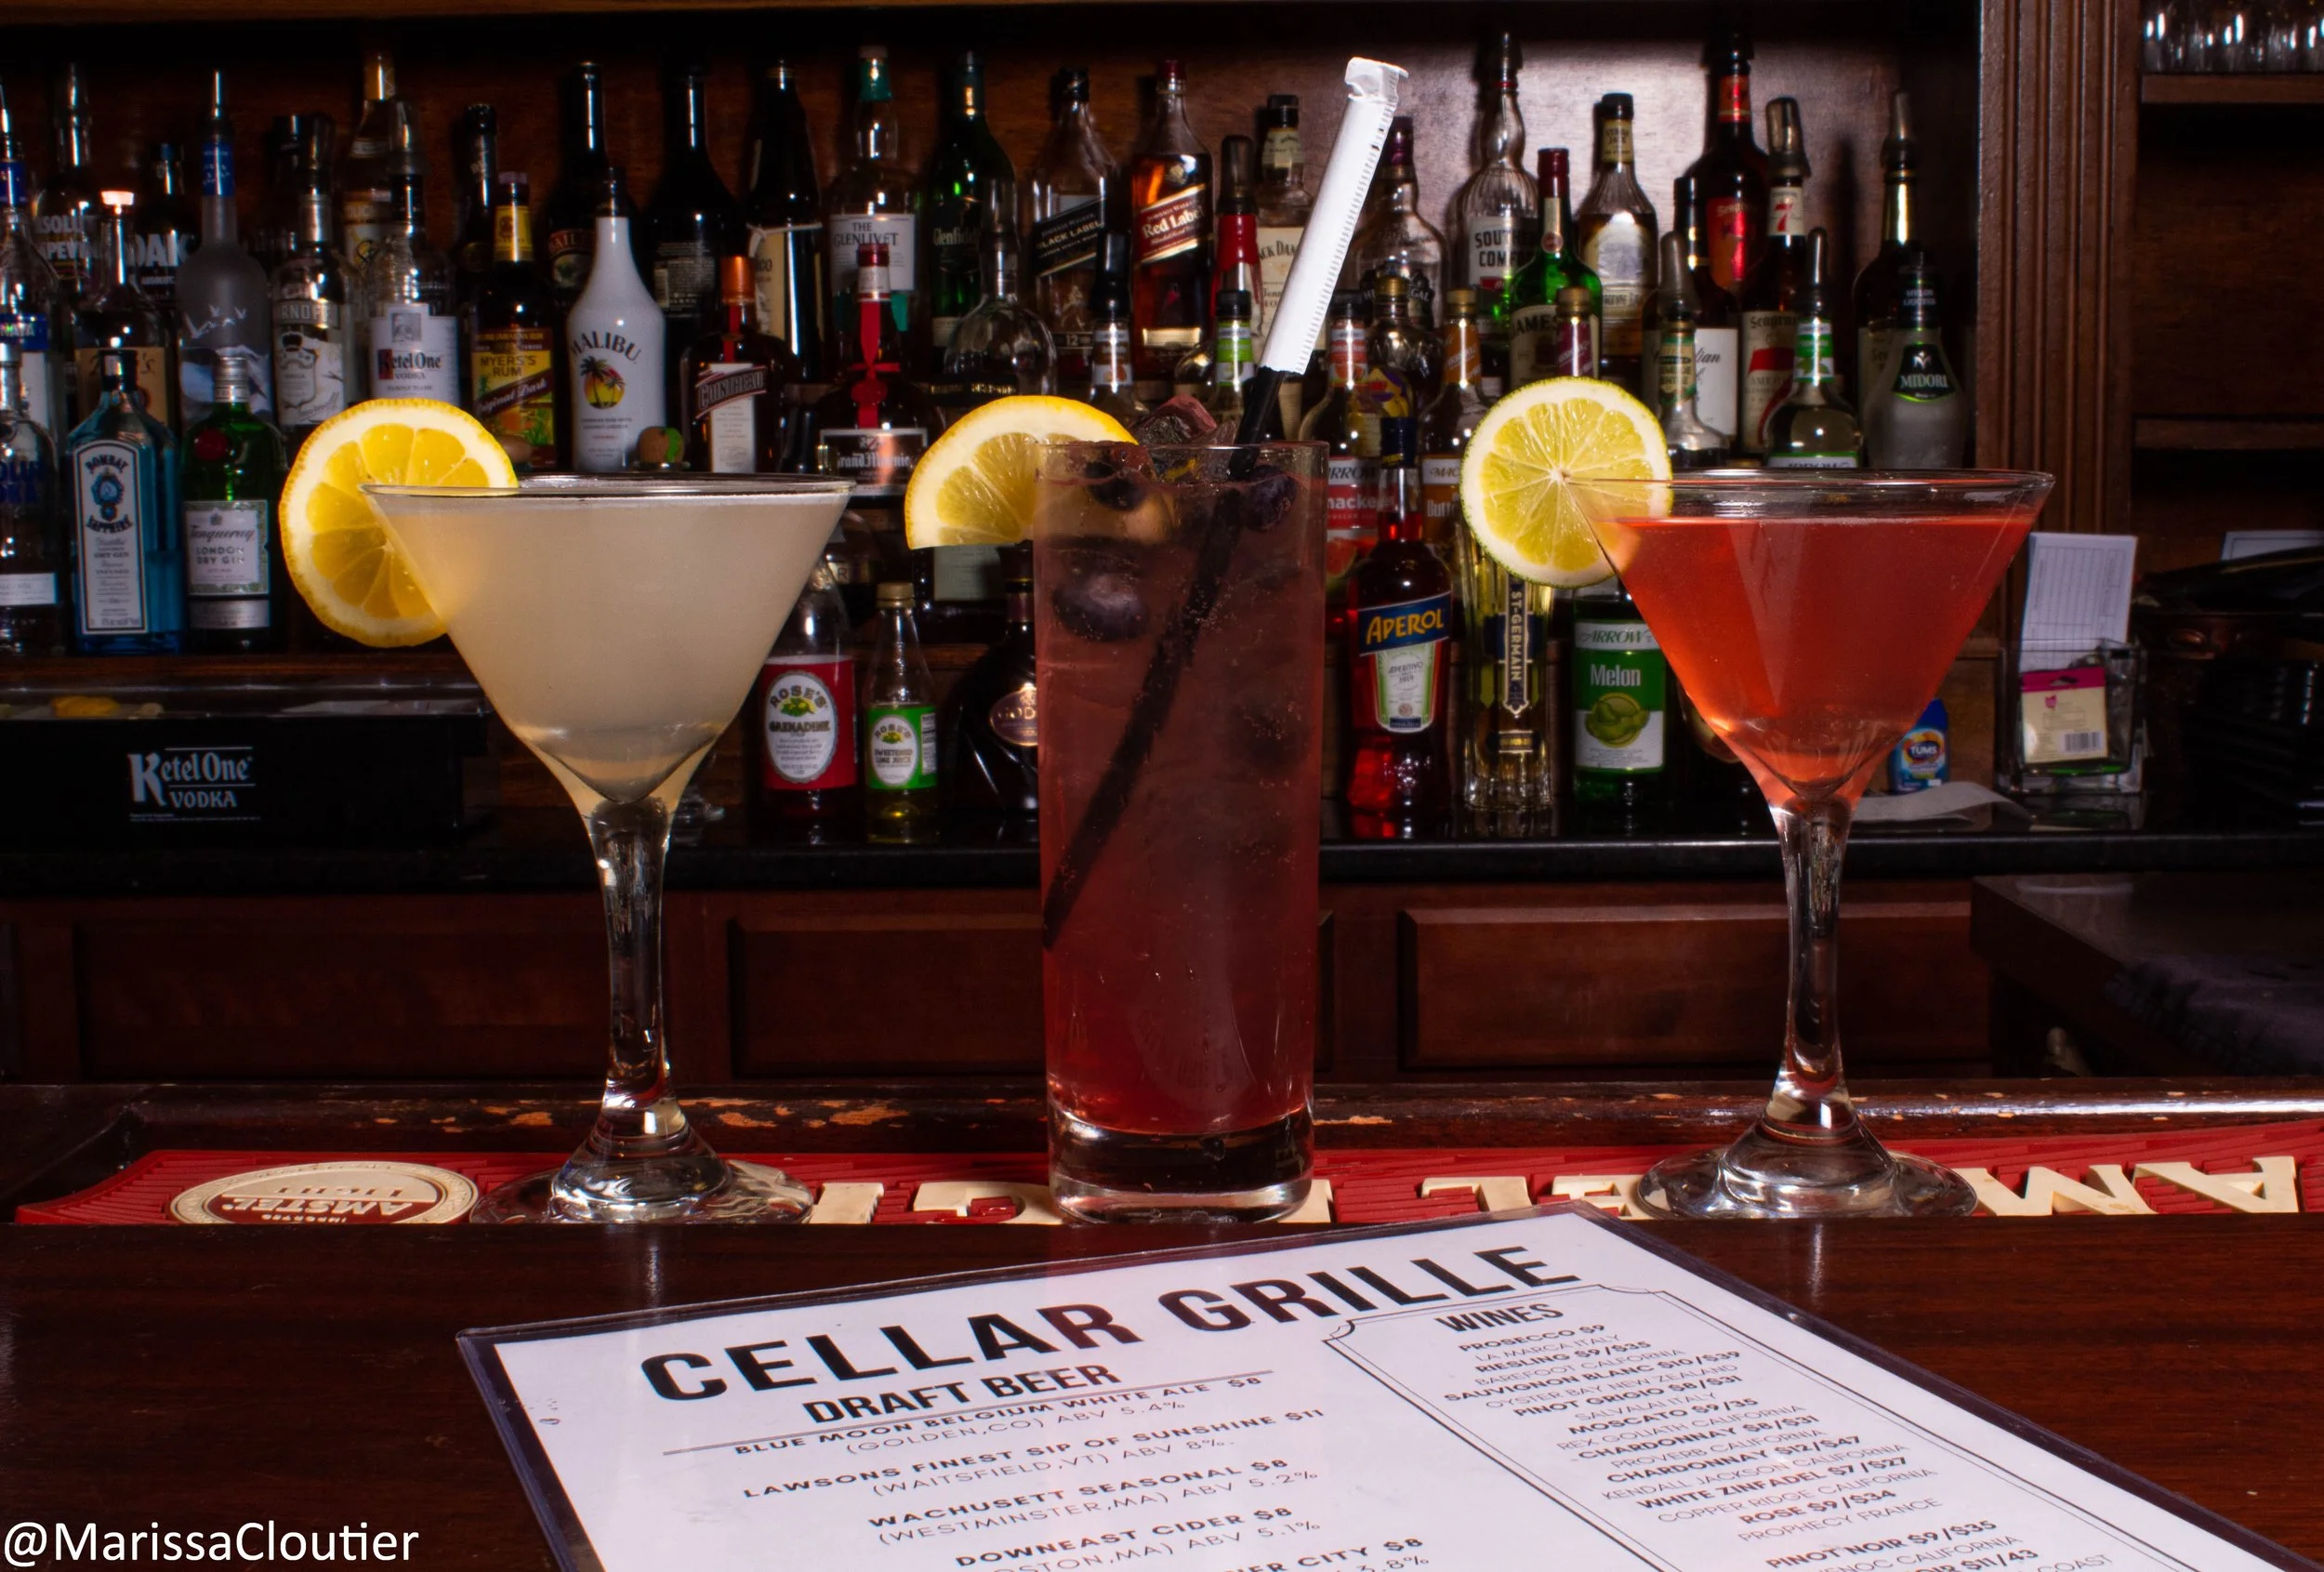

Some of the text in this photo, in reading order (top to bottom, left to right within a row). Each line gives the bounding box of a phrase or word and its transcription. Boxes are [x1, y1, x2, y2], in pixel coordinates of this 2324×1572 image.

[852, 222, 873, 231] THE
[1071, 220, 1103, 237] LABEL
[1142, 204, 1204, 239] Red Label
[1775, 203, 1794, 232] 7
[833, 231, 899, 246] GLENLIVET
[415, 350, 442, 370] One
[571, 331, 641, 363] MALIBU
[492, 366, 522, 376] RUM
[1900, 374, 1949, 389] MIDORI
[517, 376, 548, 401] Dark
[699, 372, 765, 409] COINTREAU
[86, 454, 130, 474] BOMBAY
[86, 513, 133, 535] SAPPHIRE
[190, 523, 256, 543] Tanqueray
[195, 546, 244, 555] LONDON
[1366, 609, 1446, 645] APEROL
[1510, 590, 1523, 682] ST-GERMAIN
[1583, 628, 1647, 644] ARROW
[1591, 663, 1642, 688] Melon
[769, 684, 827, 709] ROSE'S
[769, 720, 830, 733] GRENADINE
[1910, 746, 1938, 756] TUMS
[126, 751, 250, 807] Ketel One
[168, 790, 238, 809] VODKA
[231, 1196, 415, 1217] AMSTEL
[641, 1246, 1582, 1401] CELLAR GRILLE
[1434, 1303, 1564, 1332] WINES
[1459, 1324, 1604, 1352] PROSECCO $9
[1474, 1334, 1621, 1362] LA MARCA ITALY
[1474, 1365, 1577, 1385] BAREFOOT
[1475, 1354, 1570, 1373] RIESLING
[802, 1365, 1122, 1423] DRAFT BEER
[1445, 1376, 1579, 1402] SAUVIGNON
[1582, 1365, 1655, 1380] BLANC
[1486, 1364, 1737, 1408] OYSTER BAY NEW ZEALAND
[1512, 1400, 1580, 1417] PINOT
[1586, 1387, 1664, 1405] GRIGIO
[1667, 1392, 1717, 1406] ITALY
[734, 1376, 1262, 1455] BLUE MOON BELGIUM WHITE ALE $8
[847, 1400, 1185, 1455] (GOLDEN,CO) ABV 5.4%
[1556, 1405, 1807, 1450] REX GOLIATH CALIFORNIA
[1567, 1409, 1688, 1434] MOSCATO
[744, 1408, 1325, 1498] LAWSONS FINEST SIP OF SUNSHINE $11
[1578, 1427, 1737, 1459] CHARDONNAY
[1610, 1430, 1828, 1469] PROVERB CALIFORNIA
[872, 1453, 1110, 1496] (WAITSFIELD,VT)
[1123, 1445, 1172, 1460] ABV
[1602, 1444, 1909, 1500] KENDALL JACKSON CALIFORNIA
[1607, 1449, 1769, 1483] CHARDONNAY
[868, 1459, 1287, 1527] WACHUSETT SEASONAL $8
[1636, 1489, 1715, 1509] WHITE
[1657, 1469, 1939, 1523] COPPER RIDGE CALIFORNIA
[878, 1470, 1318, 1546] (WESTMINSTER,MA) ABV 5.2%
[1738, 1506, 1806, 1525] ROSE
[1738, 1498, 1944, 1541] PROPHECY FRANCE
[956, 1507, 1293, 1567] DOWNEAST CIDER $8
[1188, 1532, 1241, 1550] ABV
[1257, 1520, 1321, 1538] 5.1%
[1298, 1538, 1424, 1566] CITY $8
[1765, 1547, 1842, 1569] PINOT
[1843, 1539, 1908, 1555] NOIR
[1896, 1536, 2024, 1565] CALIFORNIA
